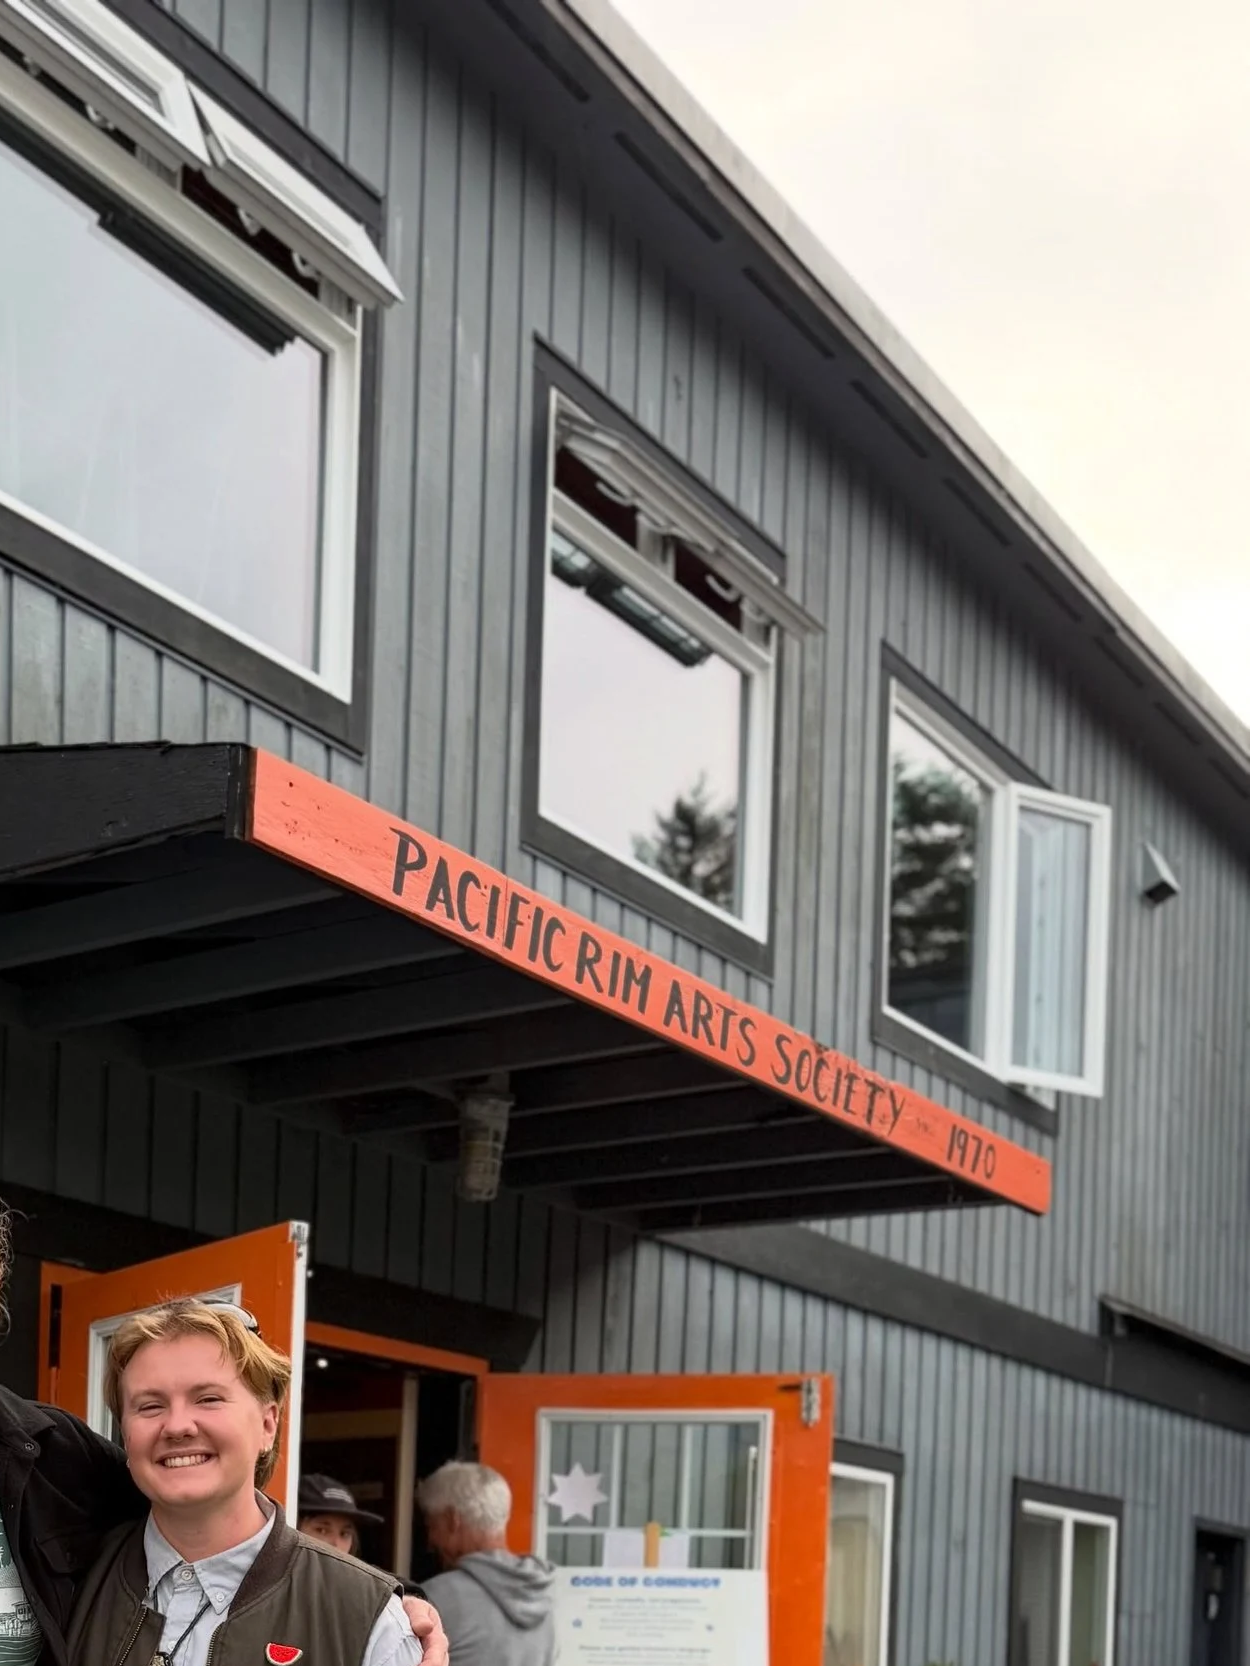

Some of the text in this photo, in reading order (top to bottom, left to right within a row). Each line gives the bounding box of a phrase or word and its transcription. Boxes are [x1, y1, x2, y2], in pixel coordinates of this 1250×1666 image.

[390, 827, 996, 1179] PACIFIC RIM ARTS SOCIETY 1970
[570, 1575, 613, 1587] CODE
[618, 1576, 638, 1587] OF
